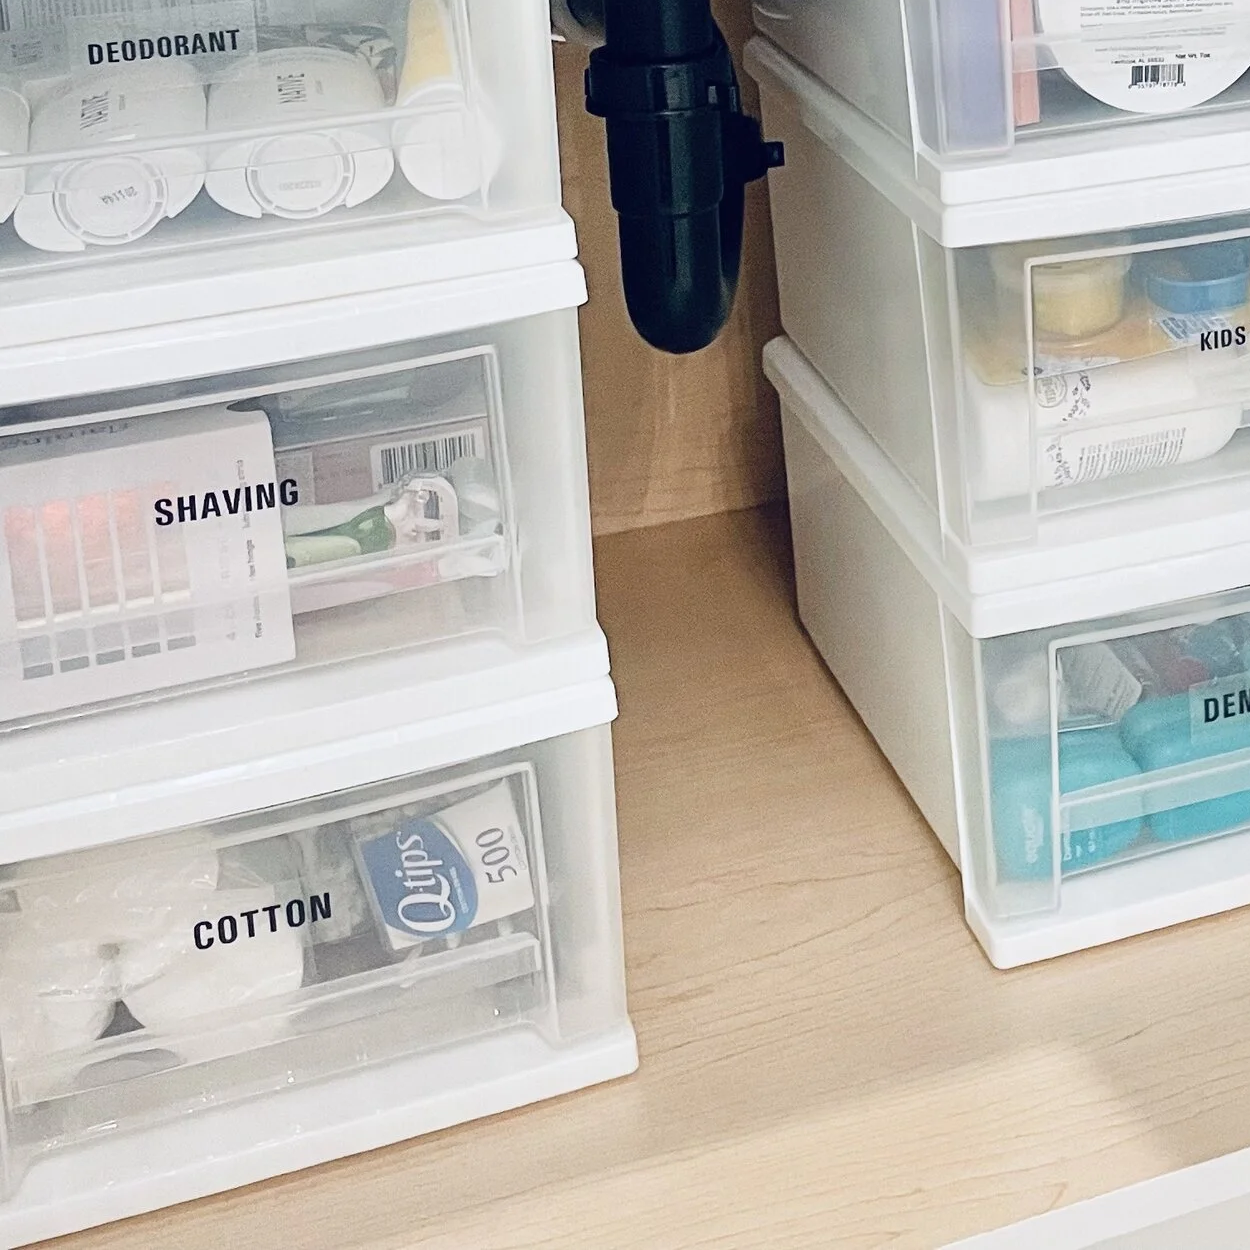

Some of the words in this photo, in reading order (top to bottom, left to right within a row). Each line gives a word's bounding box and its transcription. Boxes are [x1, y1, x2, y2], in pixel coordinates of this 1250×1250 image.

[87, 28, 241, 66] DEODORANT
[276, 73, 307, 104] NATIVE
[79, 90, 110, 130] NATIVE
[1200, 326, 1247, 352] KIDS
[154, 478, 299, 526] SHAVING
[475, 827, 519, 884] 500
[193, 892, 333, 950] COTTON
